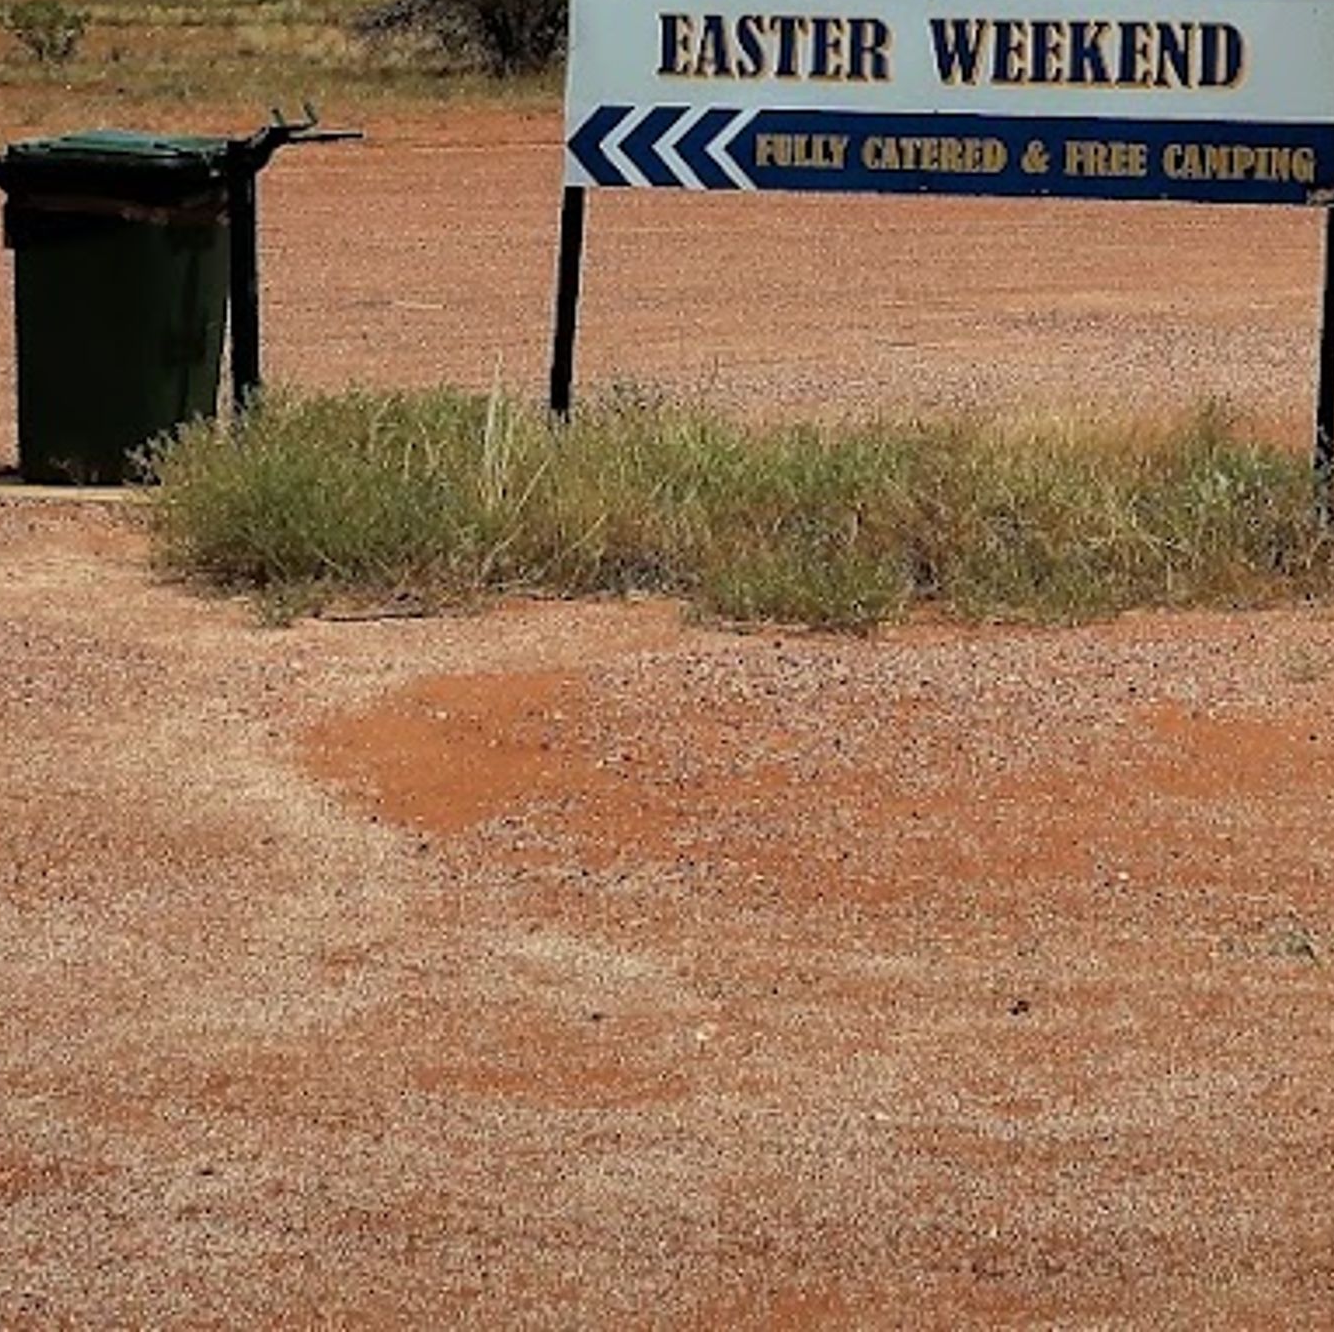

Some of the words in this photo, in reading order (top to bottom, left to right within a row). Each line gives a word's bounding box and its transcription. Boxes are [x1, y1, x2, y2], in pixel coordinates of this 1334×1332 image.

[658, 13, 894, 81] EASTER
[929, 16, 1247, 89] WEEKEND
[755, 134, 848, 170] FULLY
[861, 137, 1006, 175] CATERED
[1021, 141, 1049, 175] &
[1065, 141, 1148, 179] FREE
[1163, 146, 1317, 182] CAMPING
